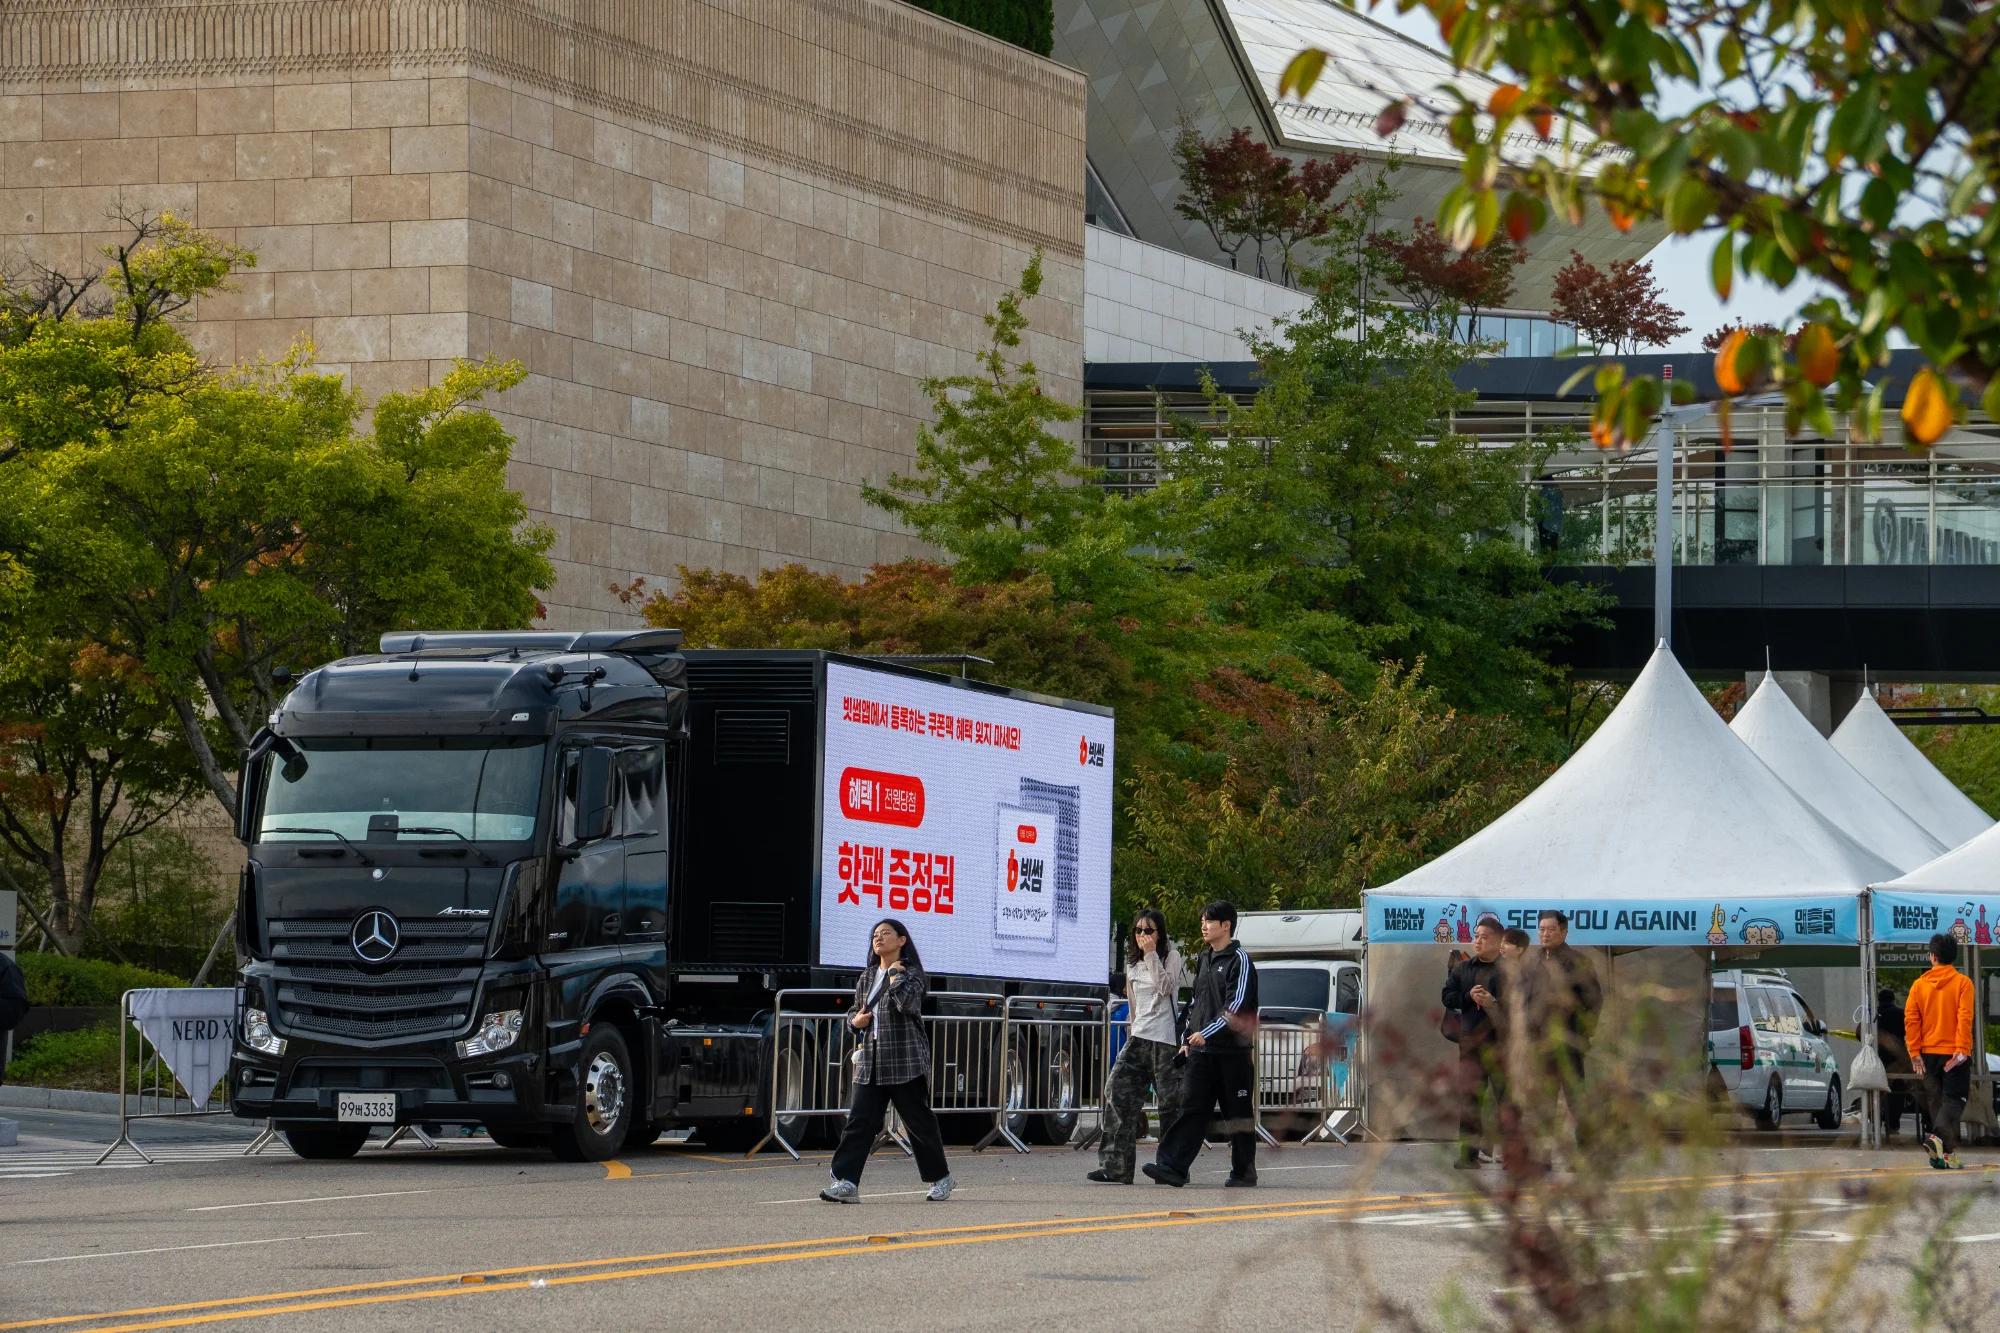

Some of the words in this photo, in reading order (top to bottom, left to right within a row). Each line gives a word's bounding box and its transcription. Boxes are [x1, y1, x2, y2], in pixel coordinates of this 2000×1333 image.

[843, 696, 889, 728] 빗썸앱에서
[891, 704, 926, 735] 등록하는
[928, 711, 954, 740] 쿠폰팩
[956, 716, 973, 743] 혜택
[975, 720, 992, 746] 잊지
[993, 724, 1021, 751] 마세요!
[1088, 741, 1105, 767] 빗썸
[848, 777, 873, 812] 혜택
[875, 781, 880, 812] 1
[884, 788, 917, 814] 전원당첨
[838, 840, 884, 909] 핫팩
[888, 848, 955, 915] 증정권
[1019, 857, 1044, 893] 빗썸
[1384, 908, 1425, 919] MADLY
[1508, 909, 1552, 929] SE
[1614, 910, 1697, 931] AGAIN!
[1893, 905, 1939, 918] MADLY
[1384, 919, 1425, 931] MEDLEY
[1893, 917, 1939, 930] MEDLEY
[172, 1019, 219, 1041] NERD
[222, 1019, 234, 1040] X
